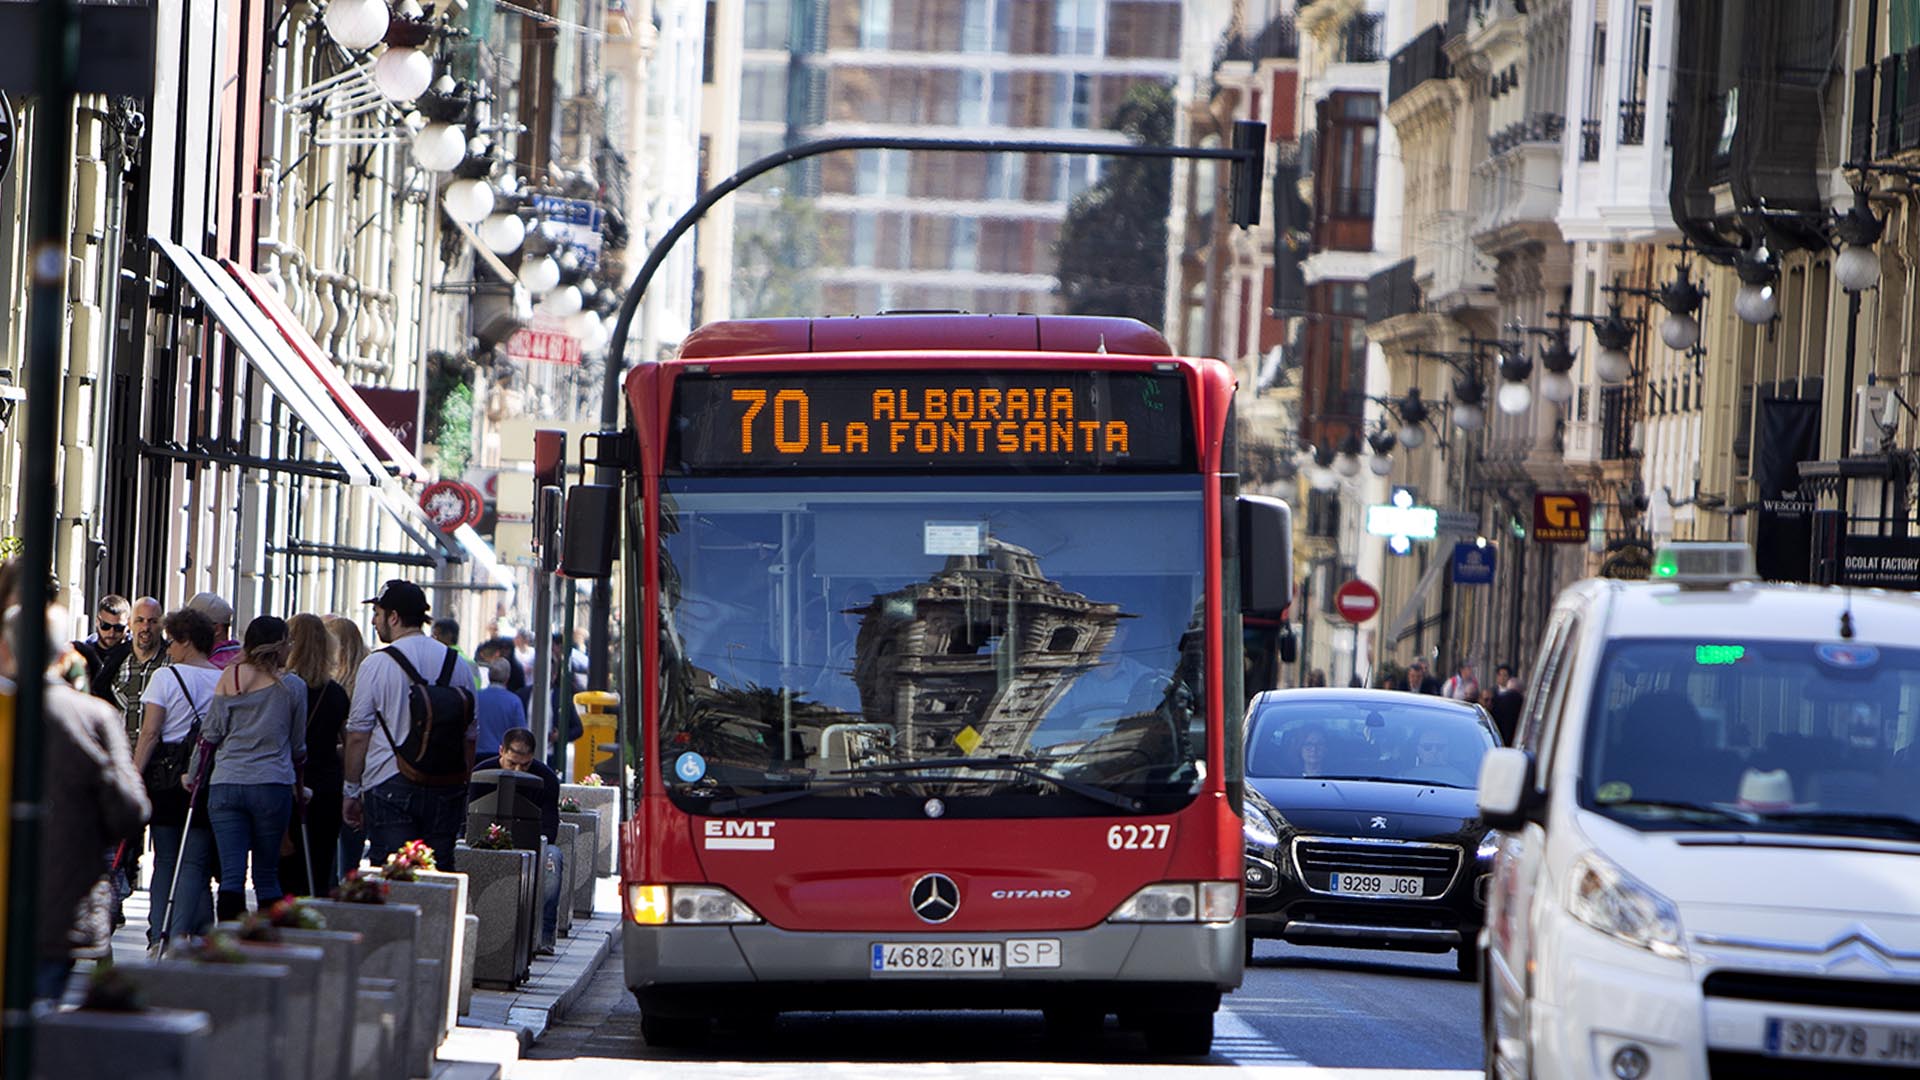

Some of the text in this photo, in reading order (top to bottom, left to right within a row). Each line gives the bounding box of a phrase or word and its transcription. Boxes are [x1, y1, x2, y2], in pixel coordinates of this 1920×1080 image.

[872, 388, 1073, 420] ALBORAIA
[731, 389, 809, 453] 70
[821, 420, 1128, 453] LA FONTSANTA
[1763, 500, 1813, 513] WESCOTT
[1881, 557, 1920, 571] FACTORY
[705, 820, 776, 837] EMT
[1107, 824, 1171, 850] 6227
[991, 889, 1071, 899] CITARO
[1343, 875, 1417, 894] 9299 JGG
[886, 947, 994, 968] 4682 GYM
[1788, 1022, 1868, 1057] 3078
